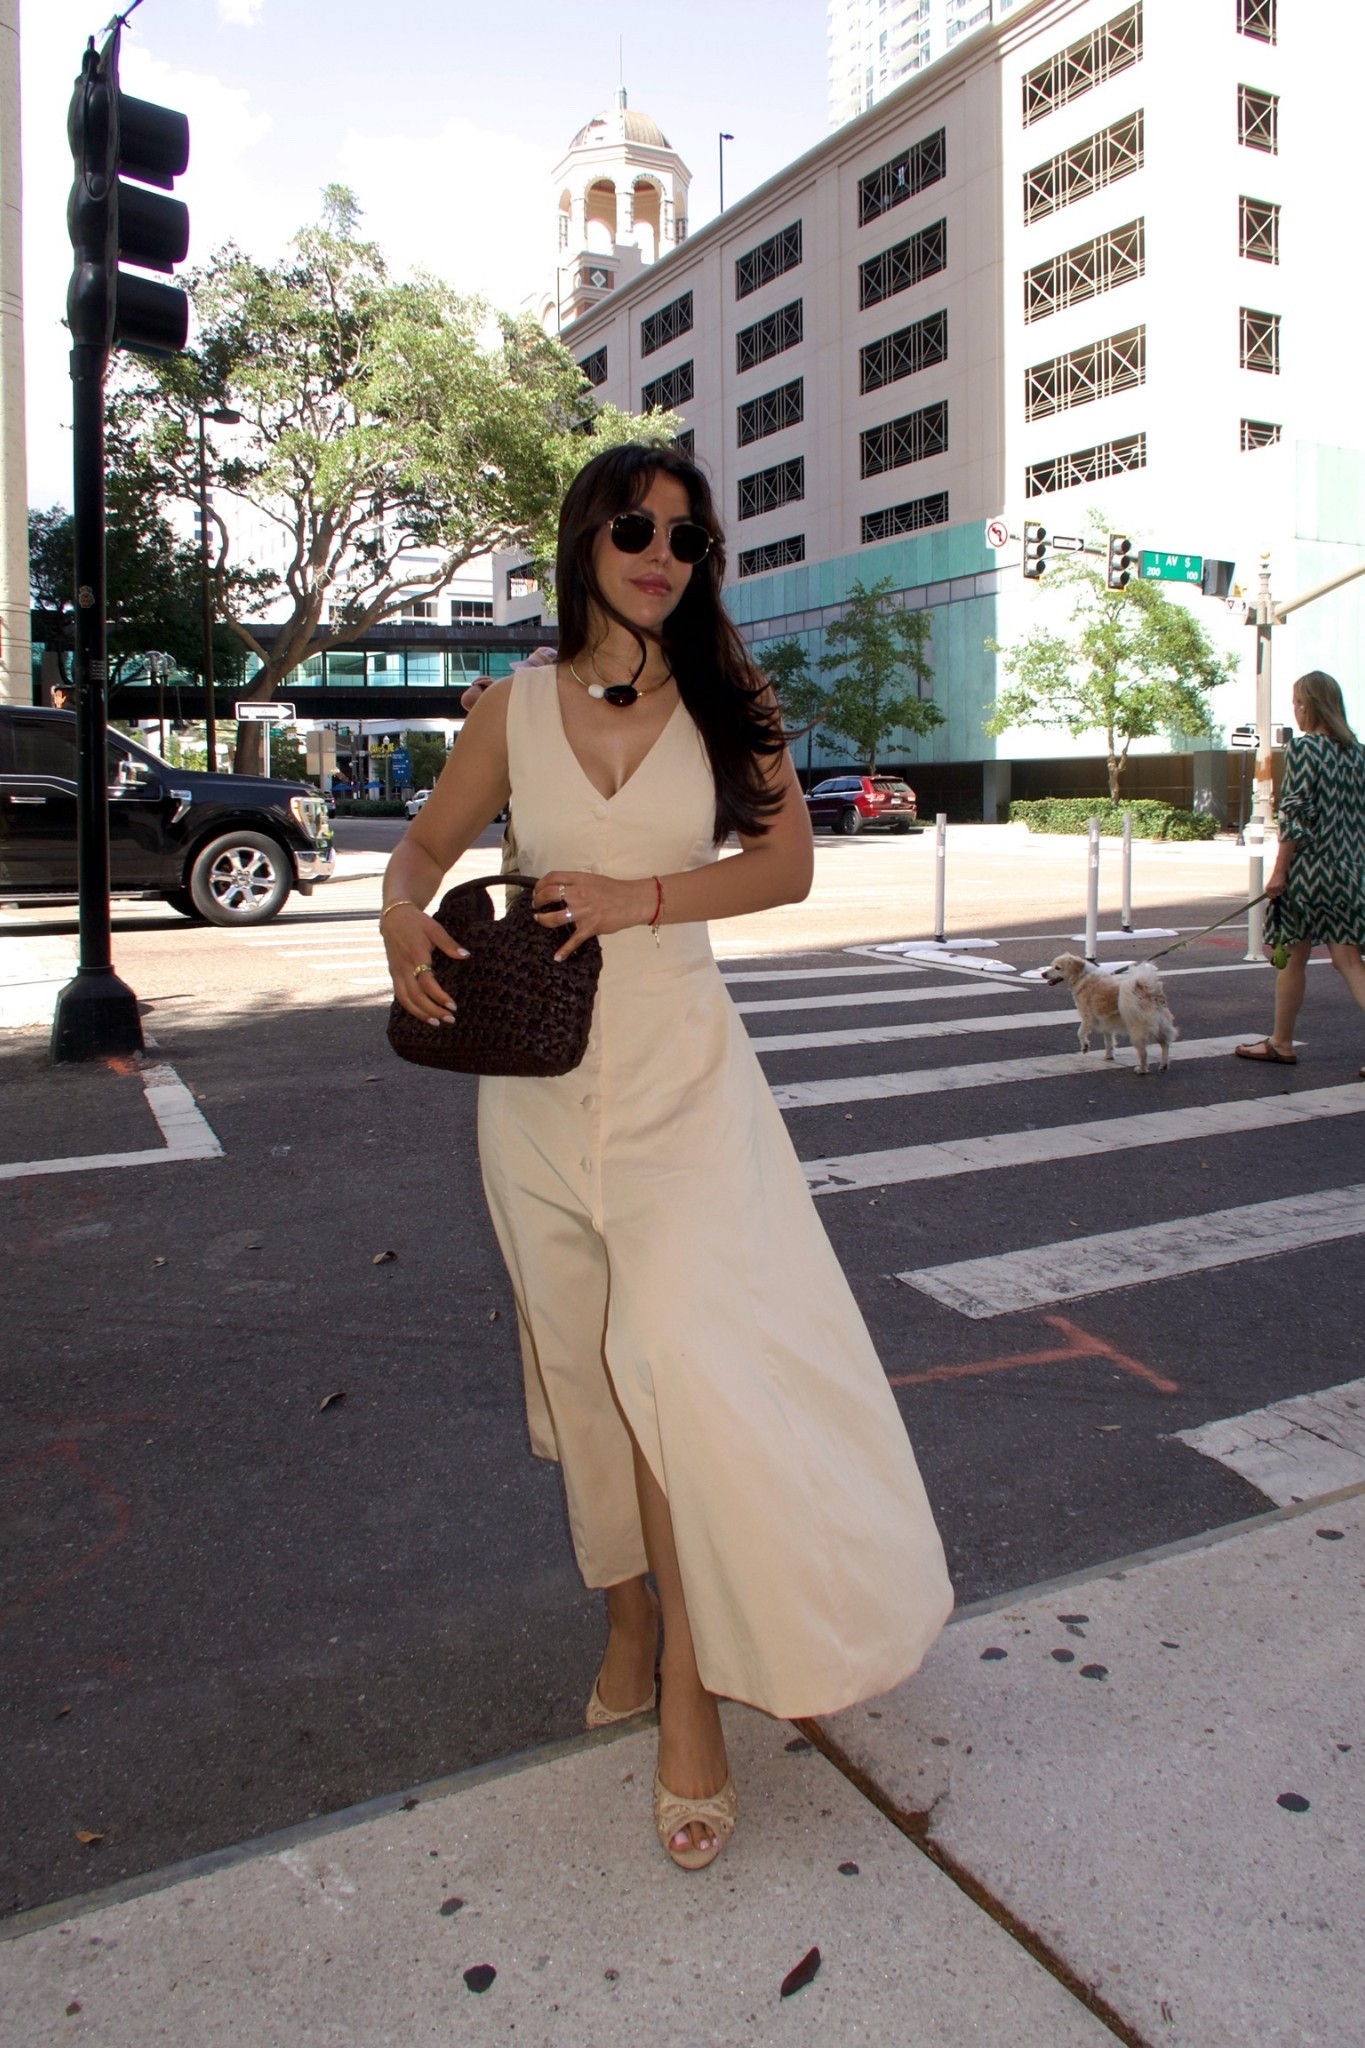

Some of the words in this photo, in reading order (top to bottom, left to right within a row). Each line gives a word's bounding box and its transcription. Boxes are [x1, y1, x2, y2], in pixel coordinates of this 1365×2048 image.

[1166, 555, 1178, 566] AV
[1184, 557, 1191, 568] S
[1146, 567, 1161, 576] 200
[1186, 571, 1198, 580] 100
